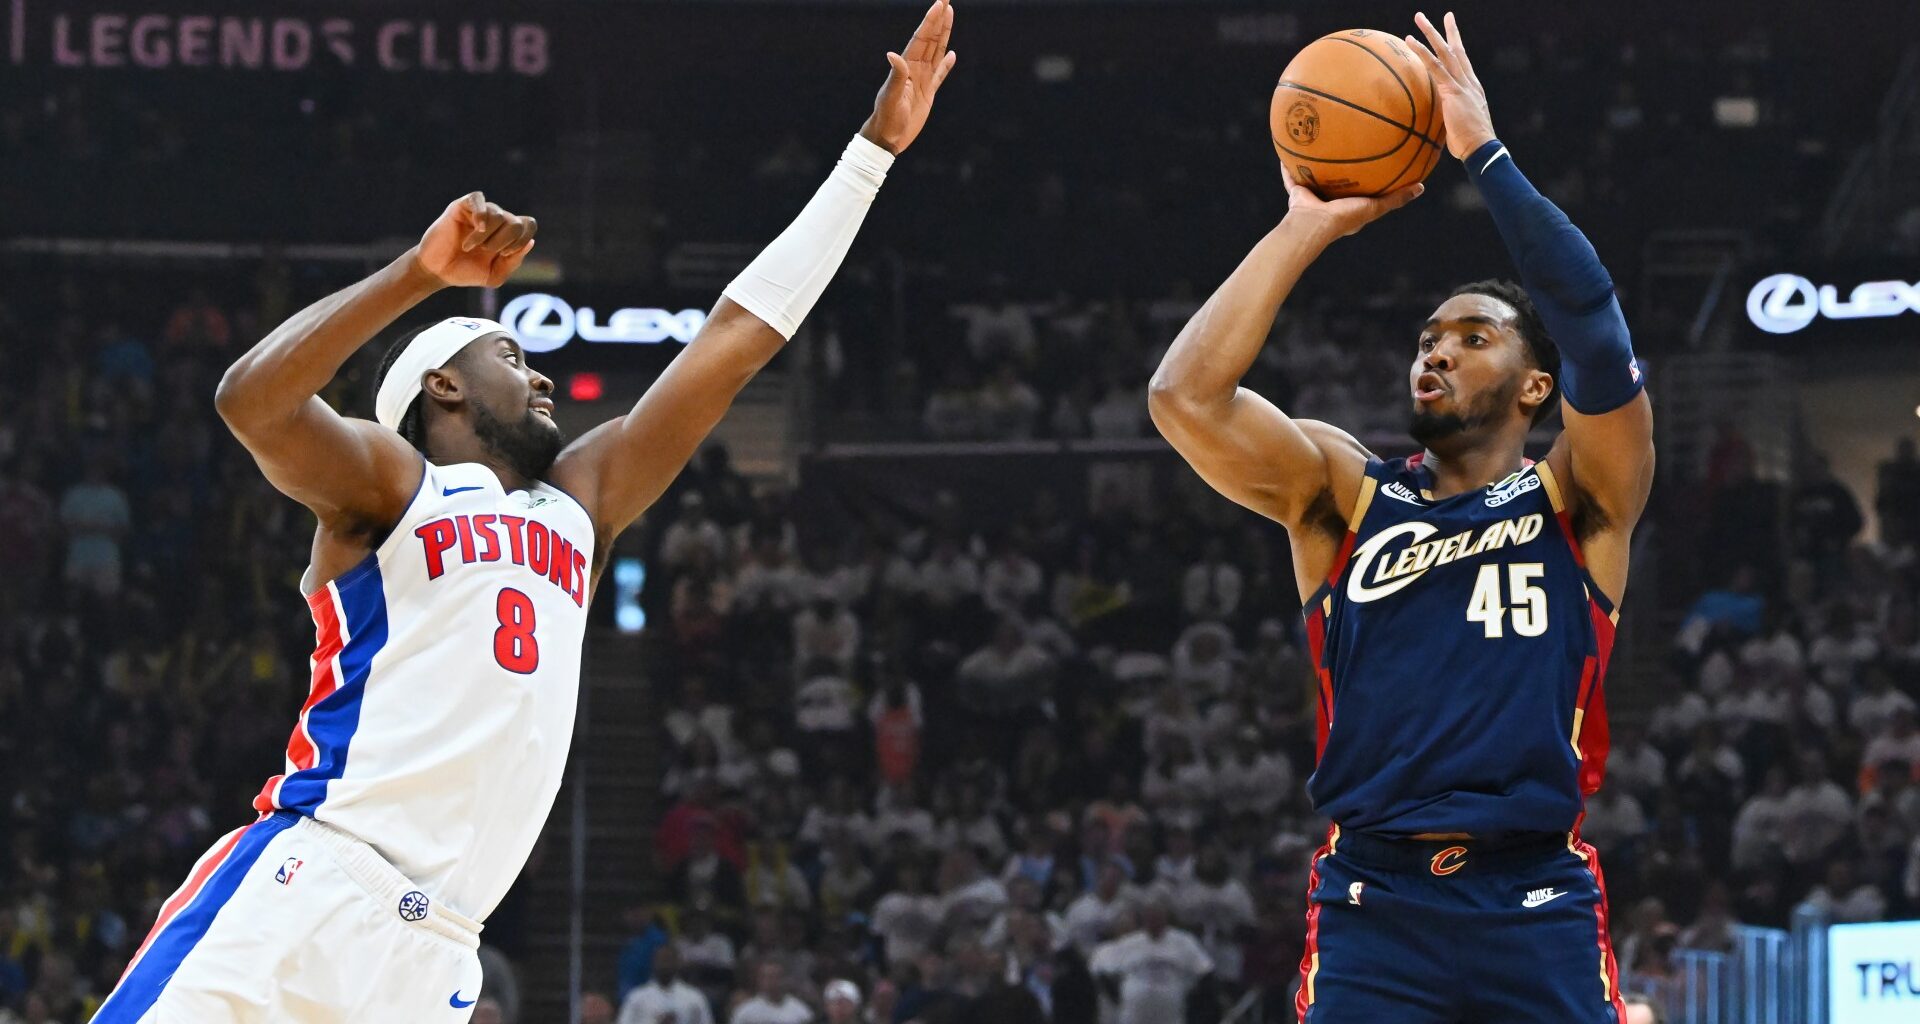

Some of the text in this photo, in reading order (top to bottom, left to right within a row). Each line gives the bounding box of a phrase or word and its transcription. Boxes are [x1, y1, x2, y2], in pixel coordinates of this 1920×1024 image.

[376, 20, 548, 75] CLUB
[1390, 480, 1420, 502] NIKE
[1486, 475, 1540, 506] CLIFFS
[414, 514, 587, 608] PISTONS
[1347, 513, 1544, 603] CLEVELAND
[493, 587, 540, 675] 8
[1466, 562, 1549, 638] 45
[1526, 887, 1555, 902] NIKE
